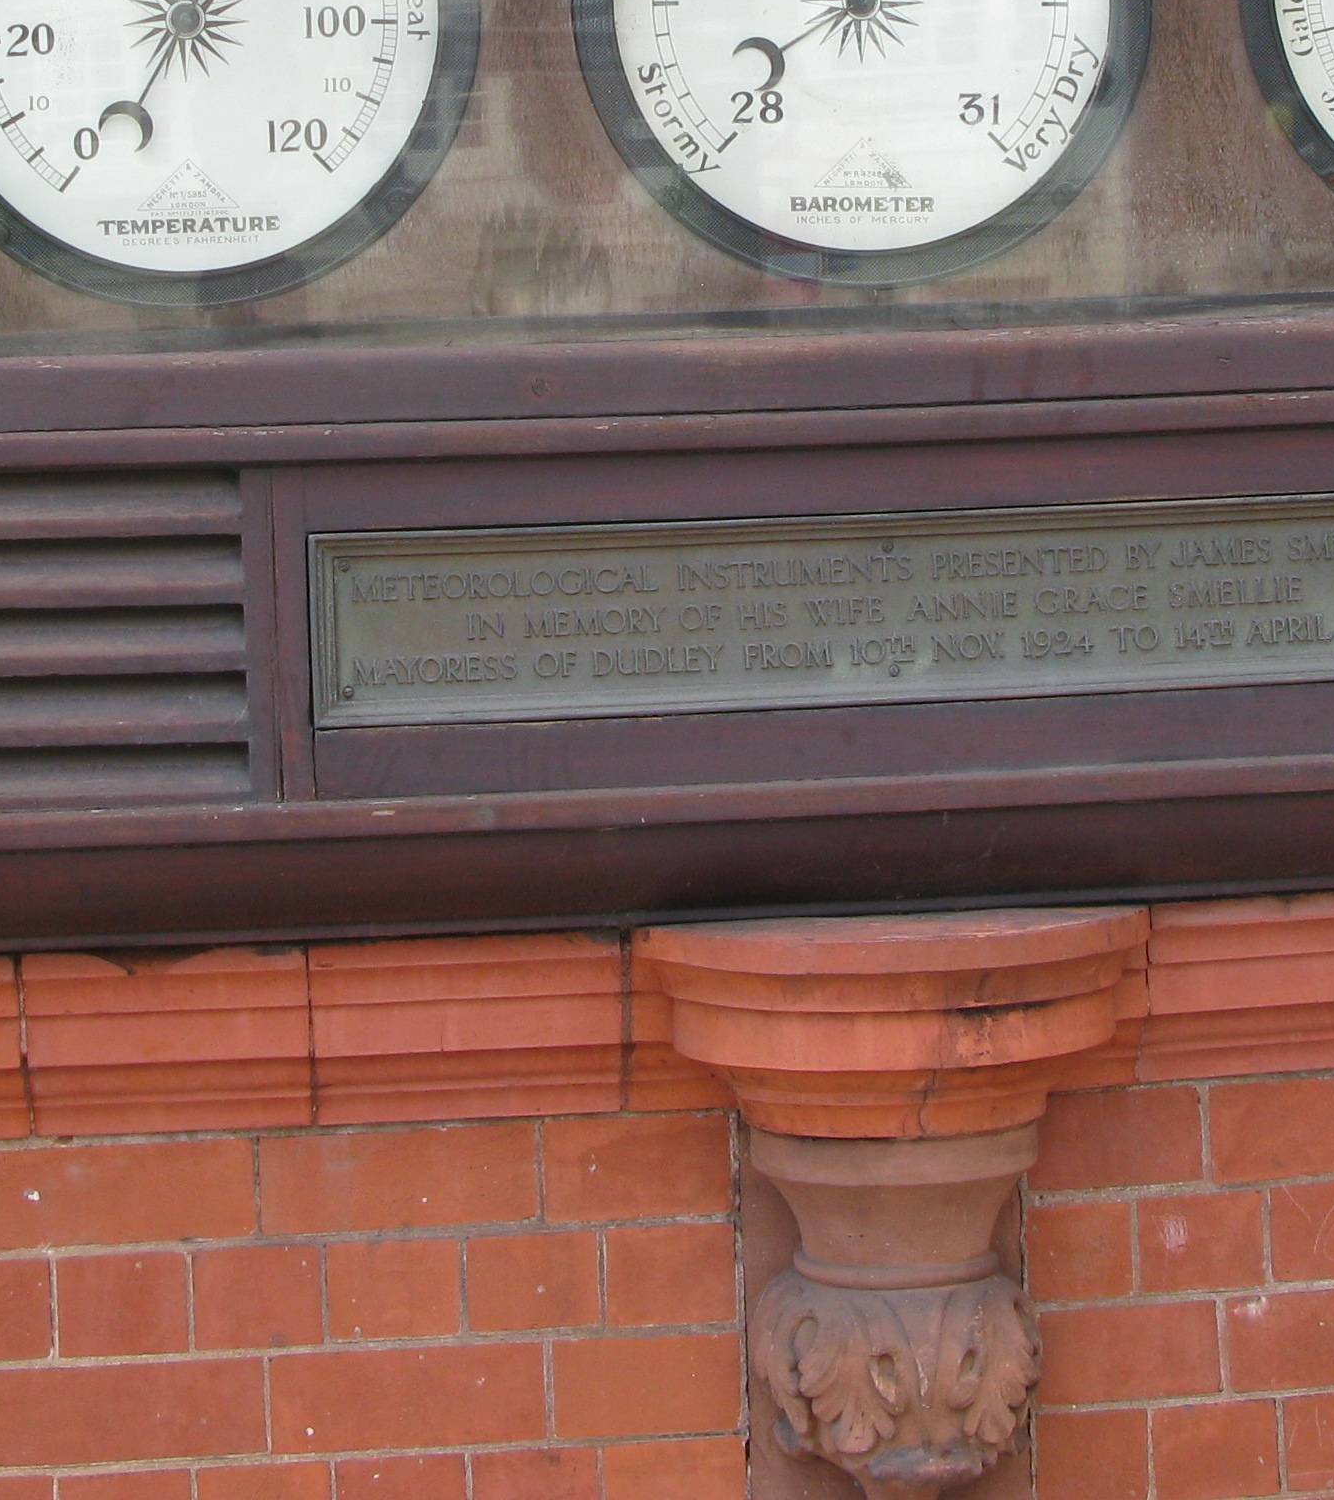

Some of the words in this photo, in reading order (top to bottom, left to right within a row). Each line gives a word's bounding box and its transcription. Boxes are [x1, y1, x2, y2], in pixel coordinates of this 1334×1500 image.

[304, 6, 365, 39] 100
[7, 23, 55, 57] 20
[323, 77, 352, 93] 110
[28, 96, 50, 112] 10
[637, 60, 721, 178] Stormy
[731, 91, 784, 124] 28
[958, 93, 1001, 126] 31
[1003, 104, 1073, 173] Very
[1056, 34, 1100, 102] Dry
[73, 126, 100, 160] 0
[267, 119, 327, 153] 120
[790, 196, 934, 212] BAROMETER
[796, 215, 841, 224] INCHES
[849, 215, 863, 224] OF
[871, 215, 929, 224] MERCURY
[96, 215, 281, 236] TEMPERATURE
[122, 236, 180, 247] DEGREES
[186, 234, 260, 244] FAHRENHEIT
[352, 566, 659, 602] METEOROLOGICAL
[677, 556, 913, 591] INSTRUMENTS
[932, 547, 1108, 579] PRESENTED
[1125, 543, 1162, 570] BY
[1170, 537, 1272, 568] JAMES
[467, 612, 504, 640] IN
[523, 607, 666, 638] MEMORY
[679, 603, 721, 631] OF
[739, 601, 787, 629] HIS
[805, 597, 884, 625] WIFE
[907, 588, 1019, 622] ANNIE
[1034, 584, 1149, 615] GRACE
[1169, 576, 1303, 609] SMELLIE
[352, 653, 518, 687] MAYORESS
[533, 649, 577, 678] OF
[592, 645, 724, 676] DUDLEY
[744, 640, 833, 669] FROM
[1021, 627, 1094, 658] 1924
[1110, 625, 1159, 653] TO
[1245, 614, 1334, 645] APRIL
